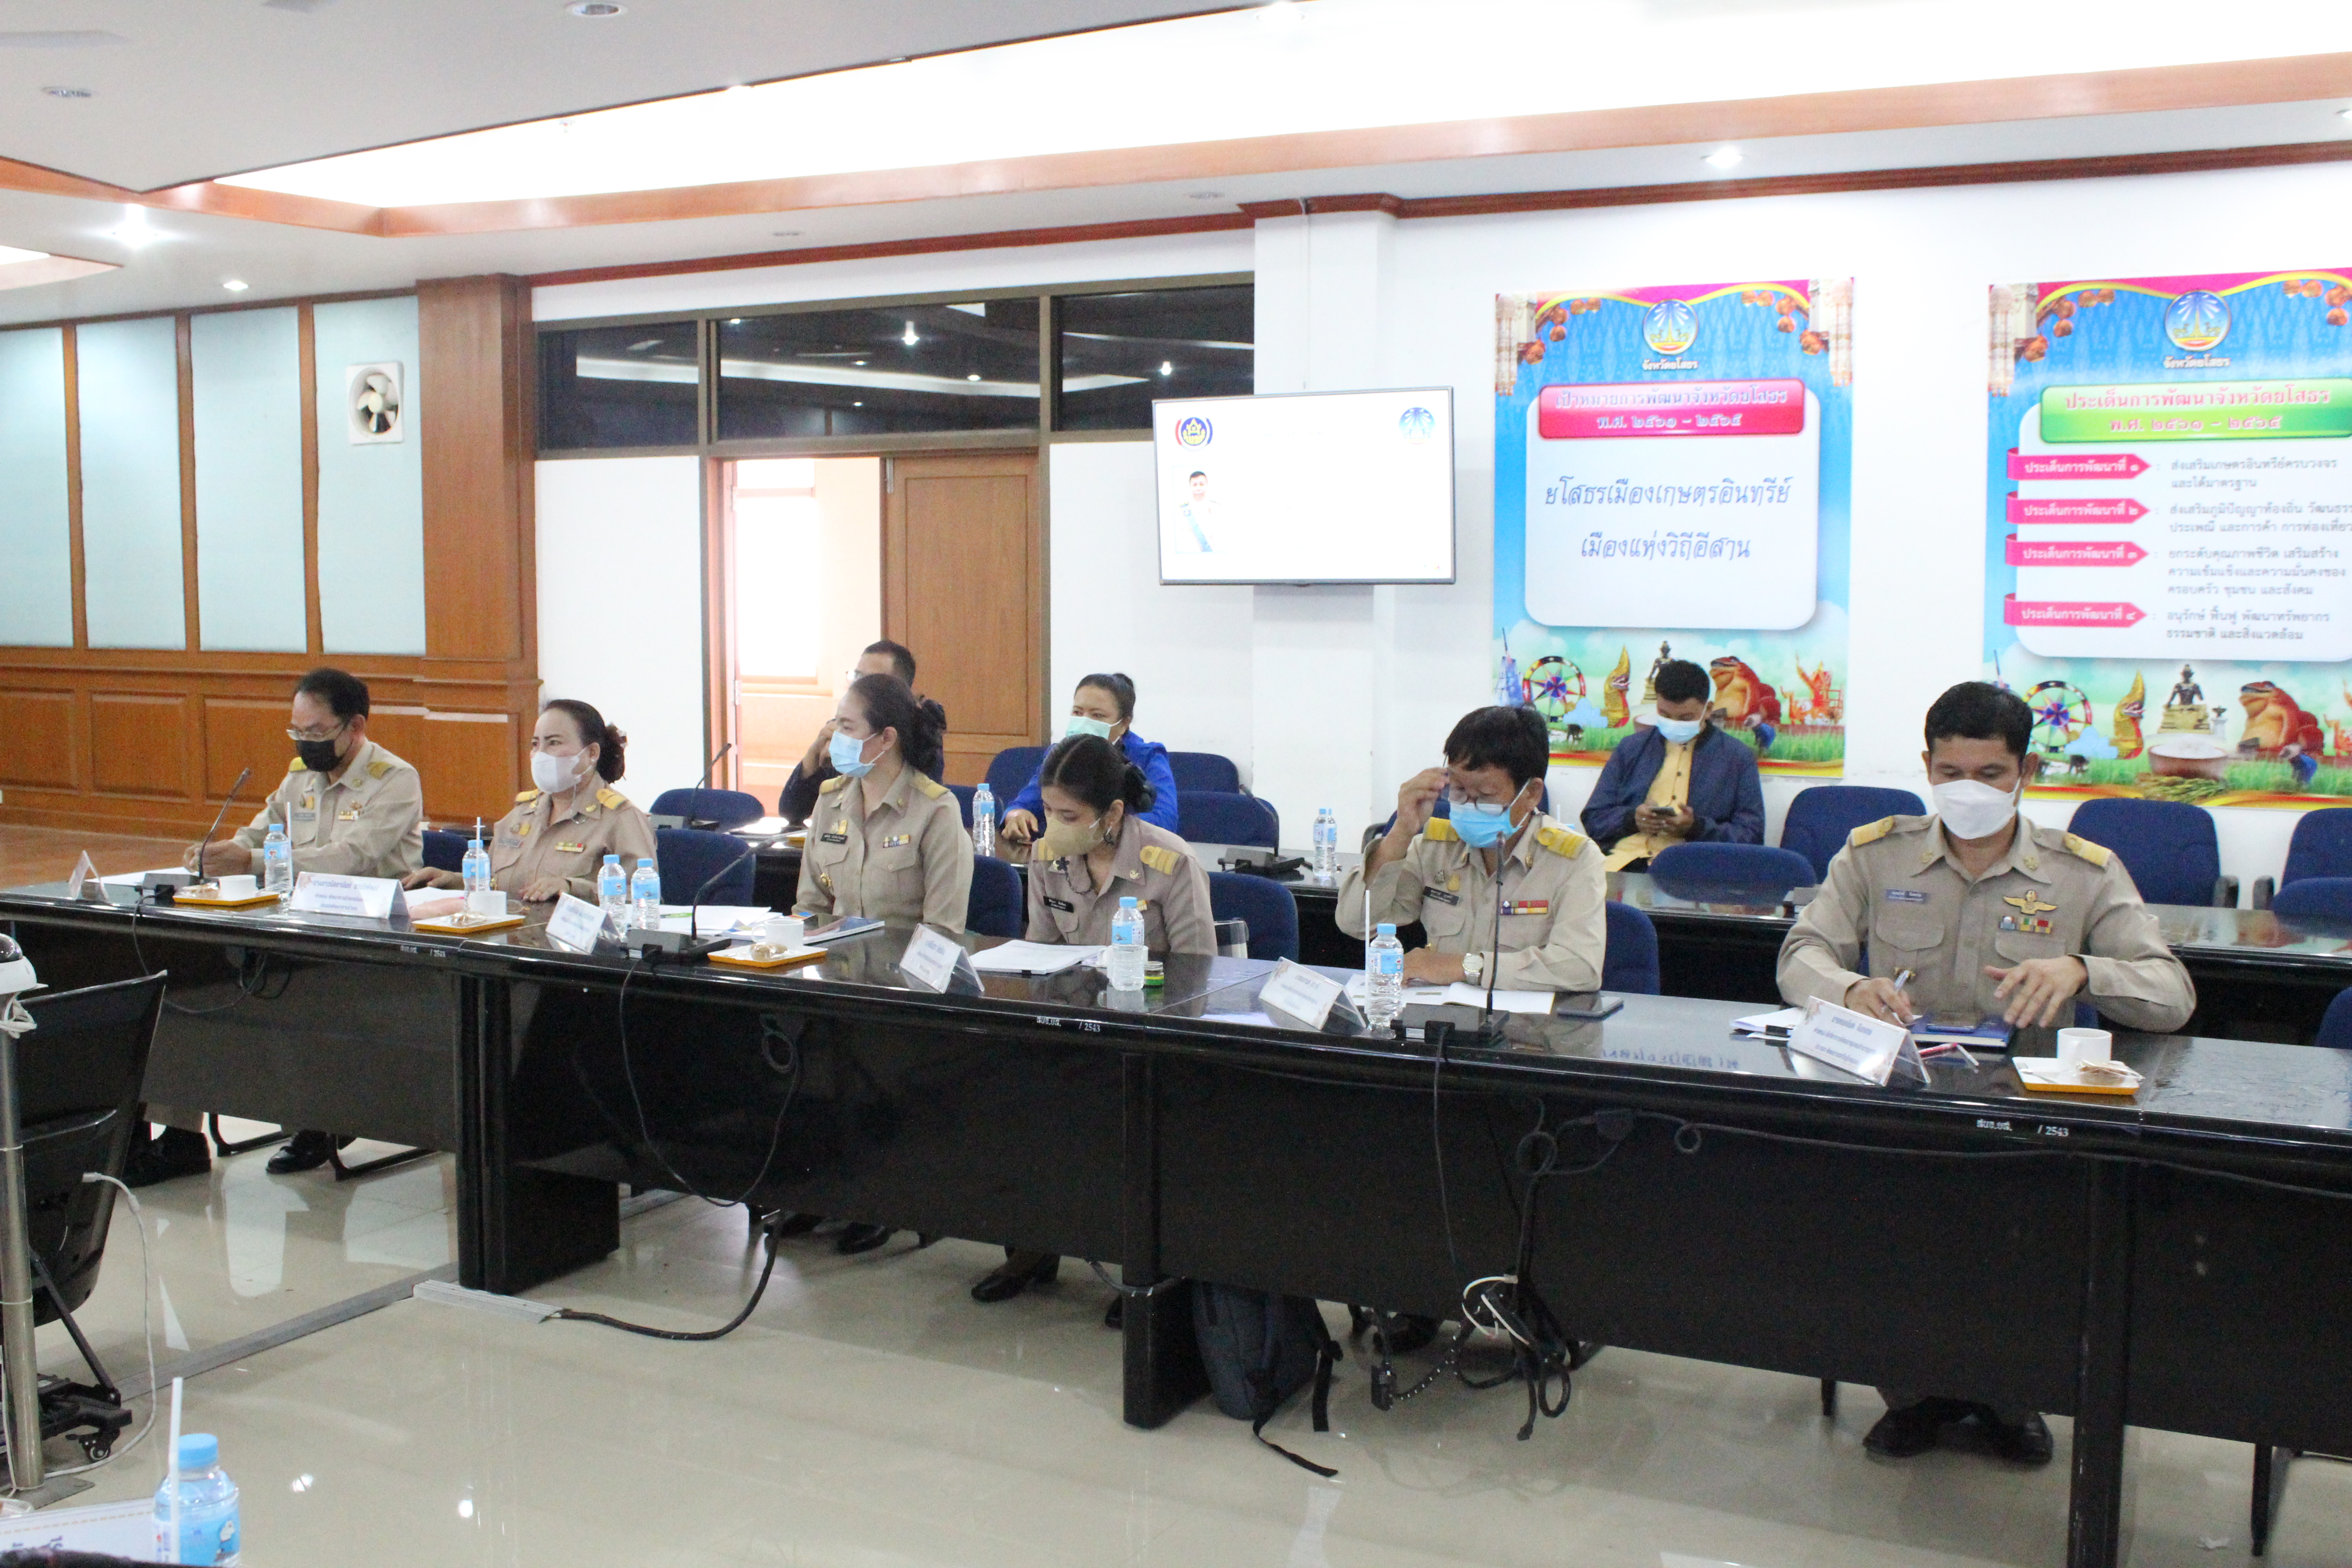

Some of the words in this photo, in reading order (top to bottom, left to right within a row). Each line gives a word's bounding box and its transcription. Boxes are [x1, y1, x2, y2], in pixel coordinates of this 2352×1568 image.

[1556, 385, 1787, 407] เป้าหมายการพัฒนาจังหวัดยโสธร
[2066, 384, 2331, 410] ประเด็นการพัฒนาจังหวัดยโสธร
[1597, 416, 1627, 428] พ.ศ.
[2110, 419, 2143, 431] พ.ศ.
[2025, 456, 2127, 473] ประเด็นการพัฒนาที่
[1545, 476, 1794, 506] ยโสธรเมืองเกษตรอินทรีย์
[2171, 476, 2258, 491] และได้มาตรฐาน
[2024, 501, 2126, 516] ประเด็นการพัฒนาที่
[1581, 530, 1750, 561] เมืองแห่งวิถีอีสาน
[2023, 544, 2124, 559] ประเด็นการพัฒนาที่
[2022, 606, 2122, 620] ประเด็นการพัฒนาที่
[1084, 1023, 1101, 1032] 2543
[2045, 1126, 2069, 1137] 2543
